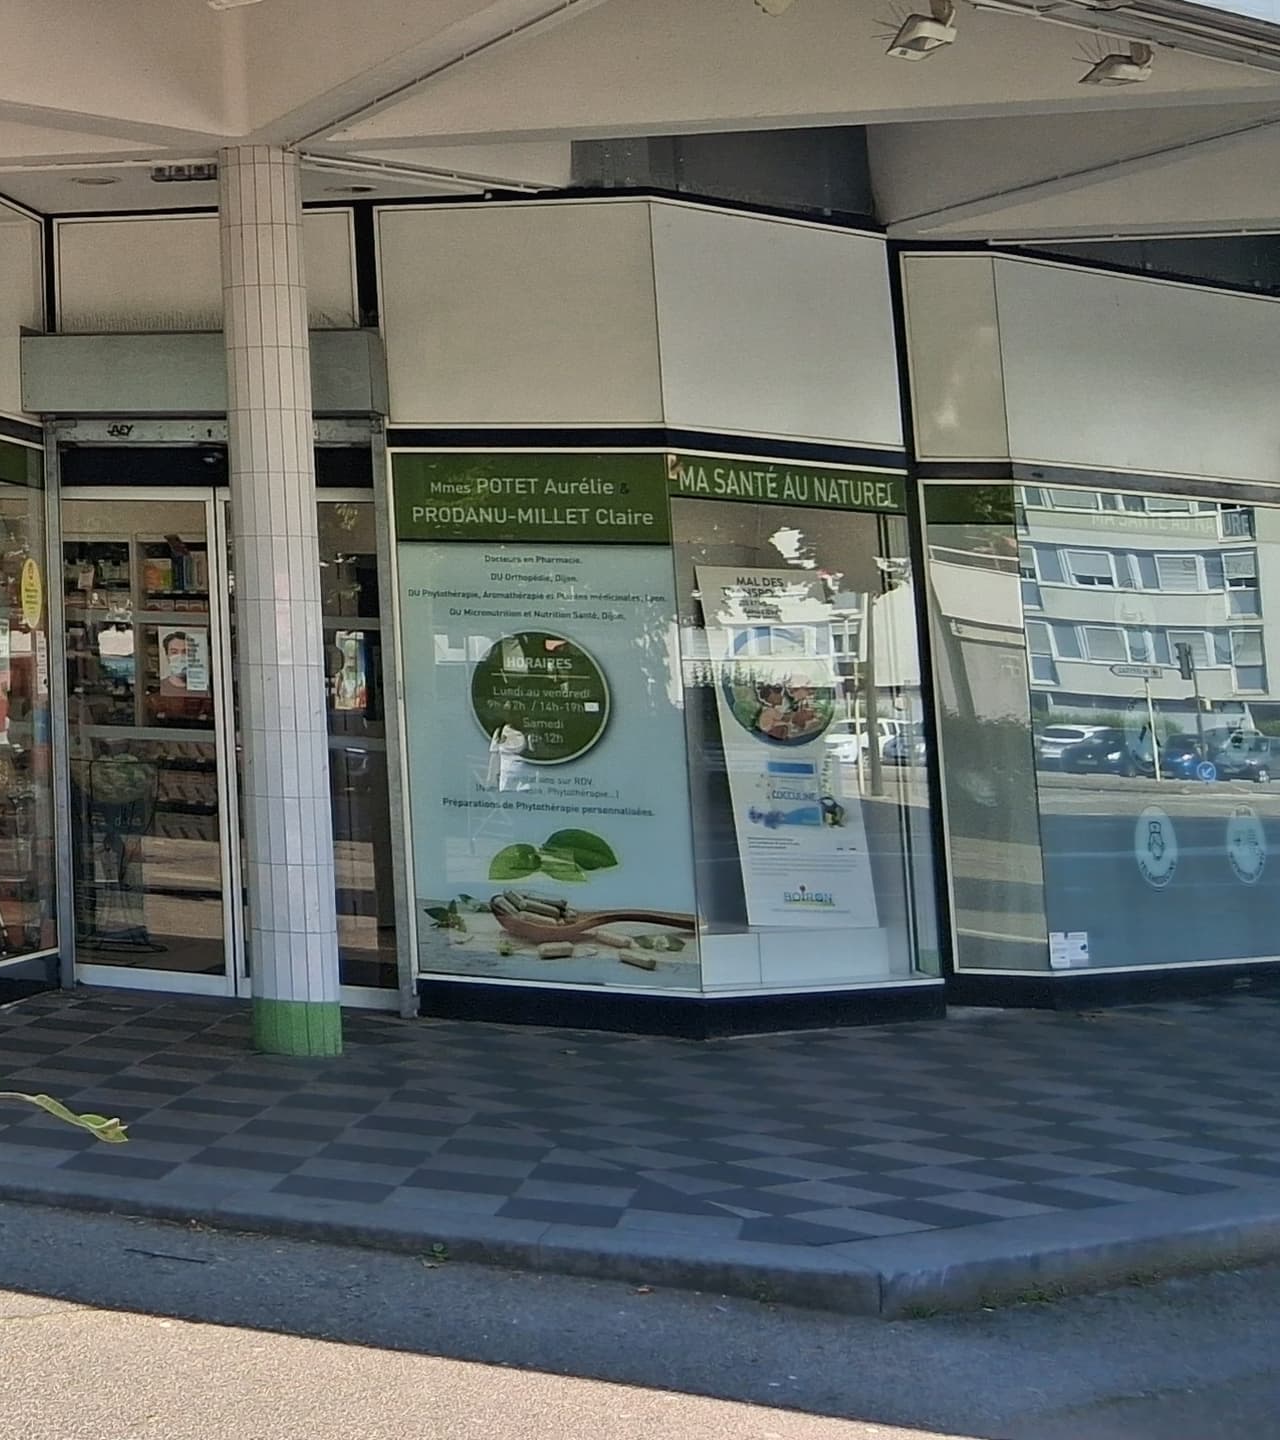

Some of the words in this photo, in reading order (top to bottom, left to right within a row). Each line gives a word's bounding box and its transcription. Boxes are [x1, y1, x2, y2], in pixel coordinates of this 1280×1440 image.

[430, 481, 471, 494] Mmes
[476, 477, 539, 495] POTET
[544, 477, 615, 495] Aurélie
[679, 465, 709, 493] MA
[713, 465, 779, 499] SANTÉ
[783, 473, 808, 500] AU
[814, 476, 899, 508] NATUREL
[412, 506, 590, 525] PRODANU-MILLET
[595, 508, 654, 526] Claire
[490, 572, 503, 581] DU
[736, 576, 759, 587] MAL
[761, 577, 785, 587] DES
[506, 656, 573, 670] HORAIRES
[493, 686, 524, 697] Lundi
[542, 687, 591, 699] vendredi
[522, 717, 564, 729] Samedi
[502, 800, 513, 810] de
